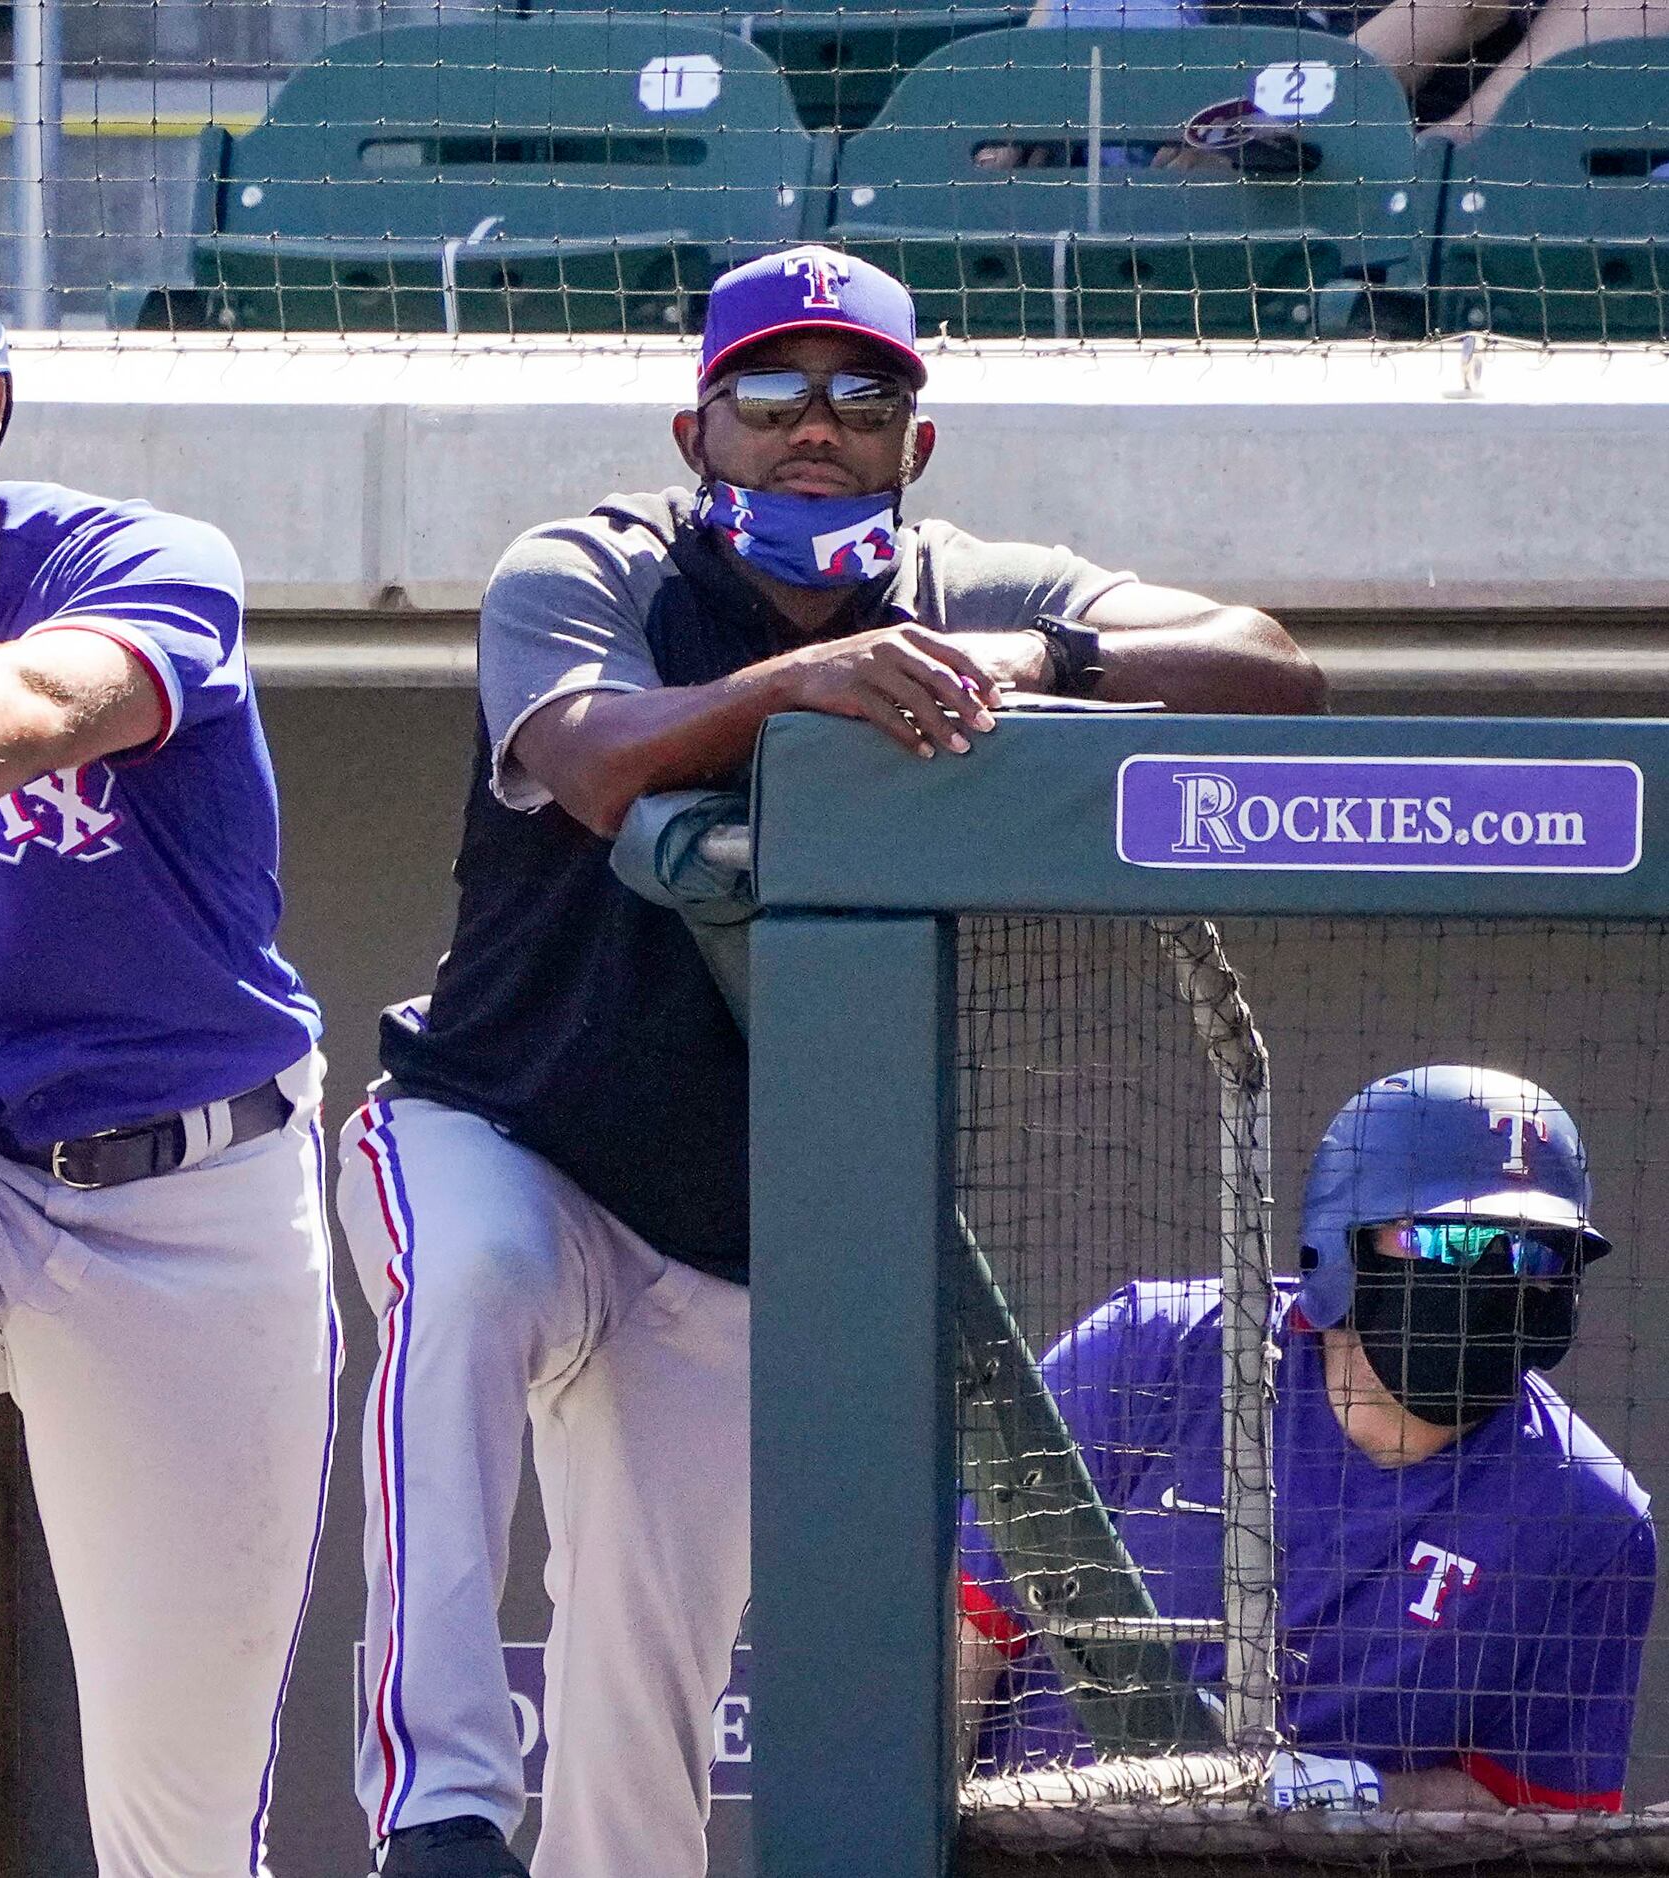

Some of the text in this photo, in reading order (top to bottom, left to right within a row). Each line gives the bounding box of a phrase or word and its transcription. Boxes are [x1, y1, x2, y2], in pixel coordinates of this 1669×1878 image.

[1282, 68, 1307, 105] 2
[784, 254, 850, 310] T
[1171, 773, 1588, 854] ROCKIES.com
[1488, 1110, 1548, 1180] T
[1408, 1540, 1478, 1627] T
